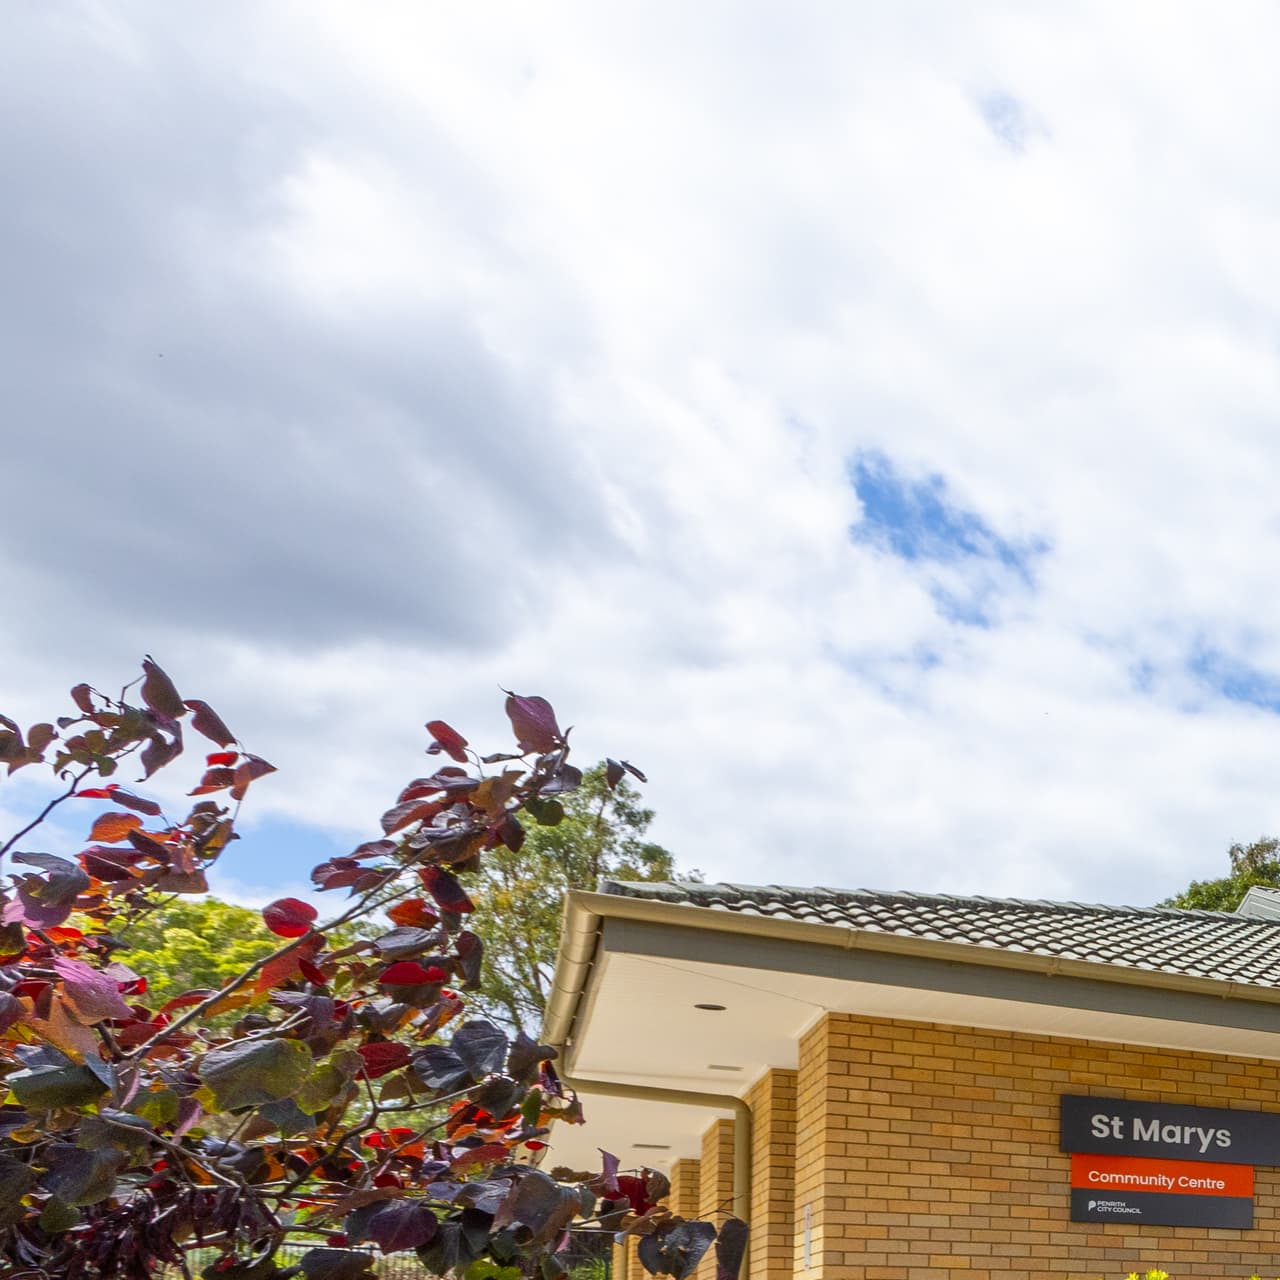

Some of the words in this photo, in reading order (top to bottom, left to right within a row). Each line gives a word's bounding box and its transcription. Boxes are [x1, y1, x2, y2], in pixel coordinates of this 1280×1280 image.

[1091, 1114, 1124, 1139] St
[1133, 1118, 1232, 1153] Marys
[1088, 1170, 1175, 1190] Community
[1178, 1176, 1225, 1189] Centre
